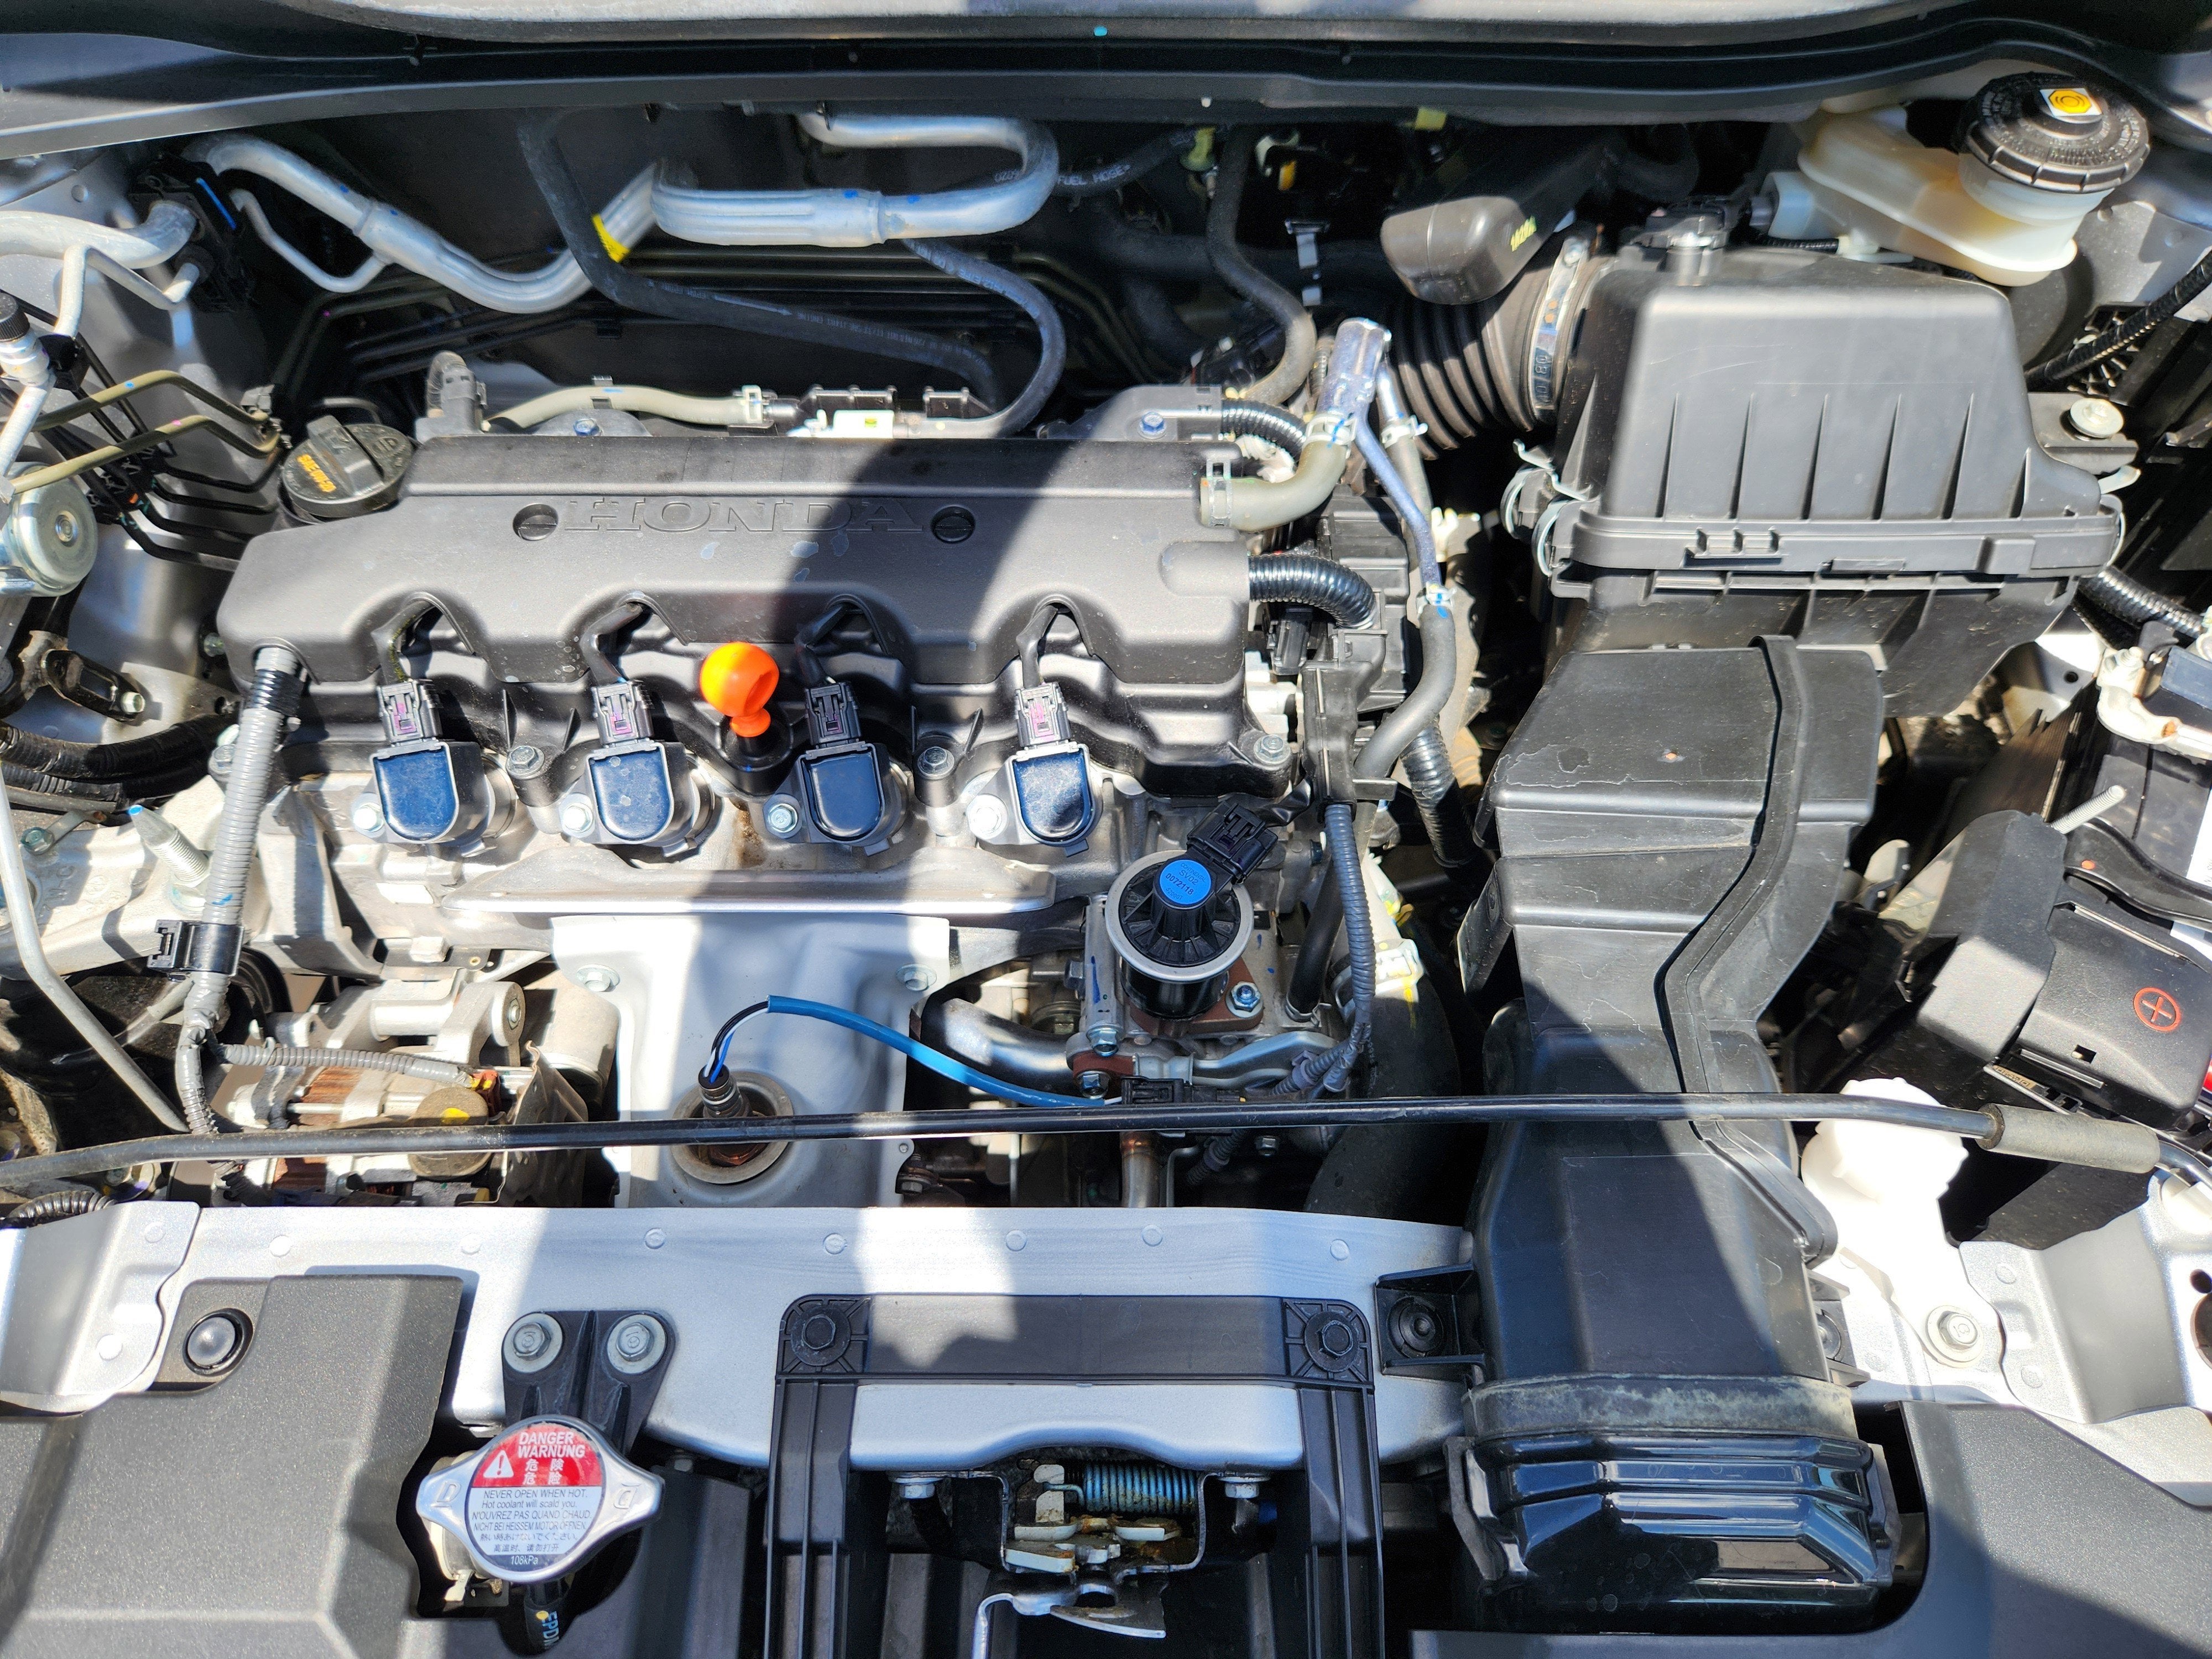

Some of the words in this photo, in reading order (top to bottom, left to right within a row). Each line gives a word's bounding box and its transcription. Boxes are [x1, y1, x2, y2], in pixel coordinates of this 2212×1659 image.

[563, 497, 924, 533] HONDA
[1179, 870, 1198, 885] SV02
[1165, 873, 1194, 895] 0072118
[519, 1431, 574, 1445] DANGER
[518, 1444, 586, 1459] WARNUNG
[483, 1489, 513, 1499] NEVER
[514, 1489, 538, 1498] OPEN
[540, 1489, 566, 1498] WHEN
[568, 1489, 588, 1498] HOT.
[482, 1500, 495, 1509] Hot
[497, 1500, 524, 1509] coolant
[526, 1499, 538, 1507] will
[539, 1499, 560, 1507] scald
[561, 1501, 577, 1509] you.
[472, 1511, 513, 1520] N'OUVREZ
[514, 1510, 530, 1519] PAS
[531, 1510, 560, 1520] QUAND
[562, 1510, 592, 1519] CHAUD.
[474, 1522, 493, 1531] NICHT
[494, 1522, 505, 1531] BEI
[506, 1521, 534, 1531] HEISSEM
[535, 1521, 559, 1530] MOTOR
[510, 1555, 539, 1566] 108kPa
